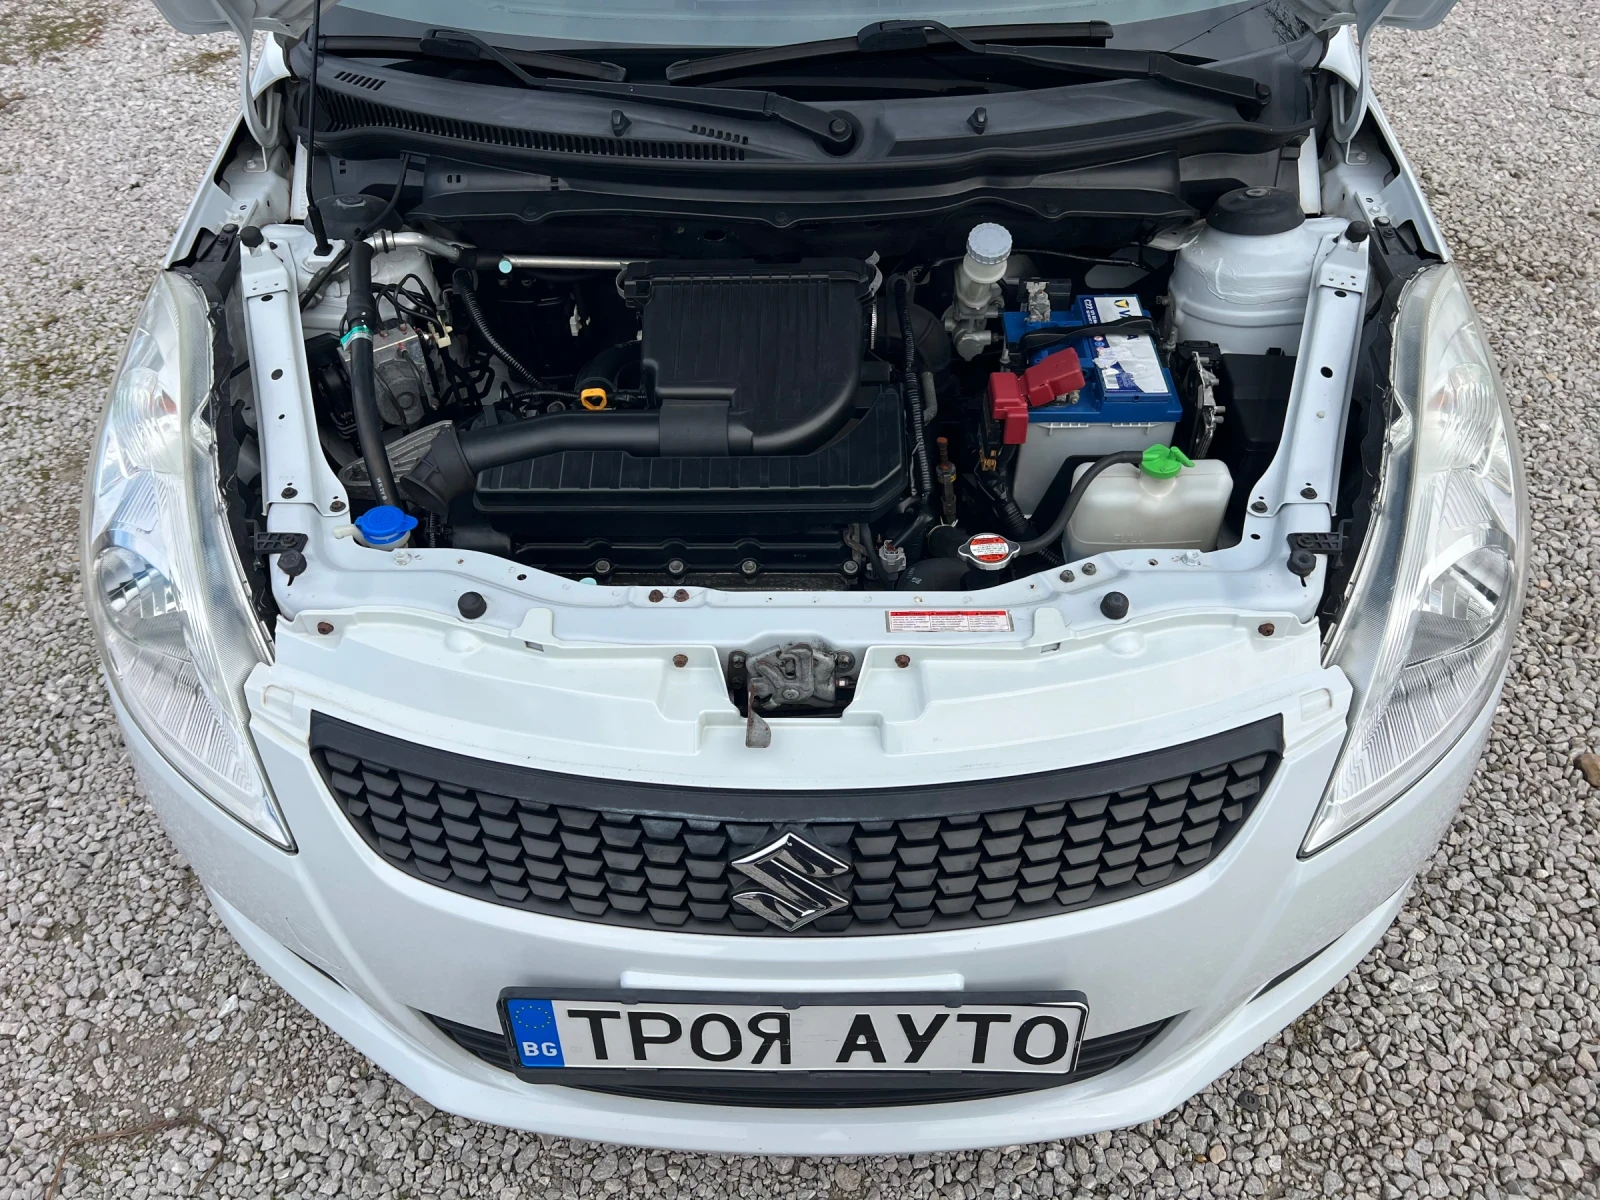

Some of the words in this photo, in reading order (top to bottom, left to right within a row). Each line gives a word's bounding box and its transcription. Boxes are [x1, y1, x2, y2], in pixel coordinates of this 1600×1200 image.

[522, 1041, 558, 1057] BG
[567, 1009, 791, 1064] ТРОЯ
[835, 1014, 1068, 1065] АУТО
